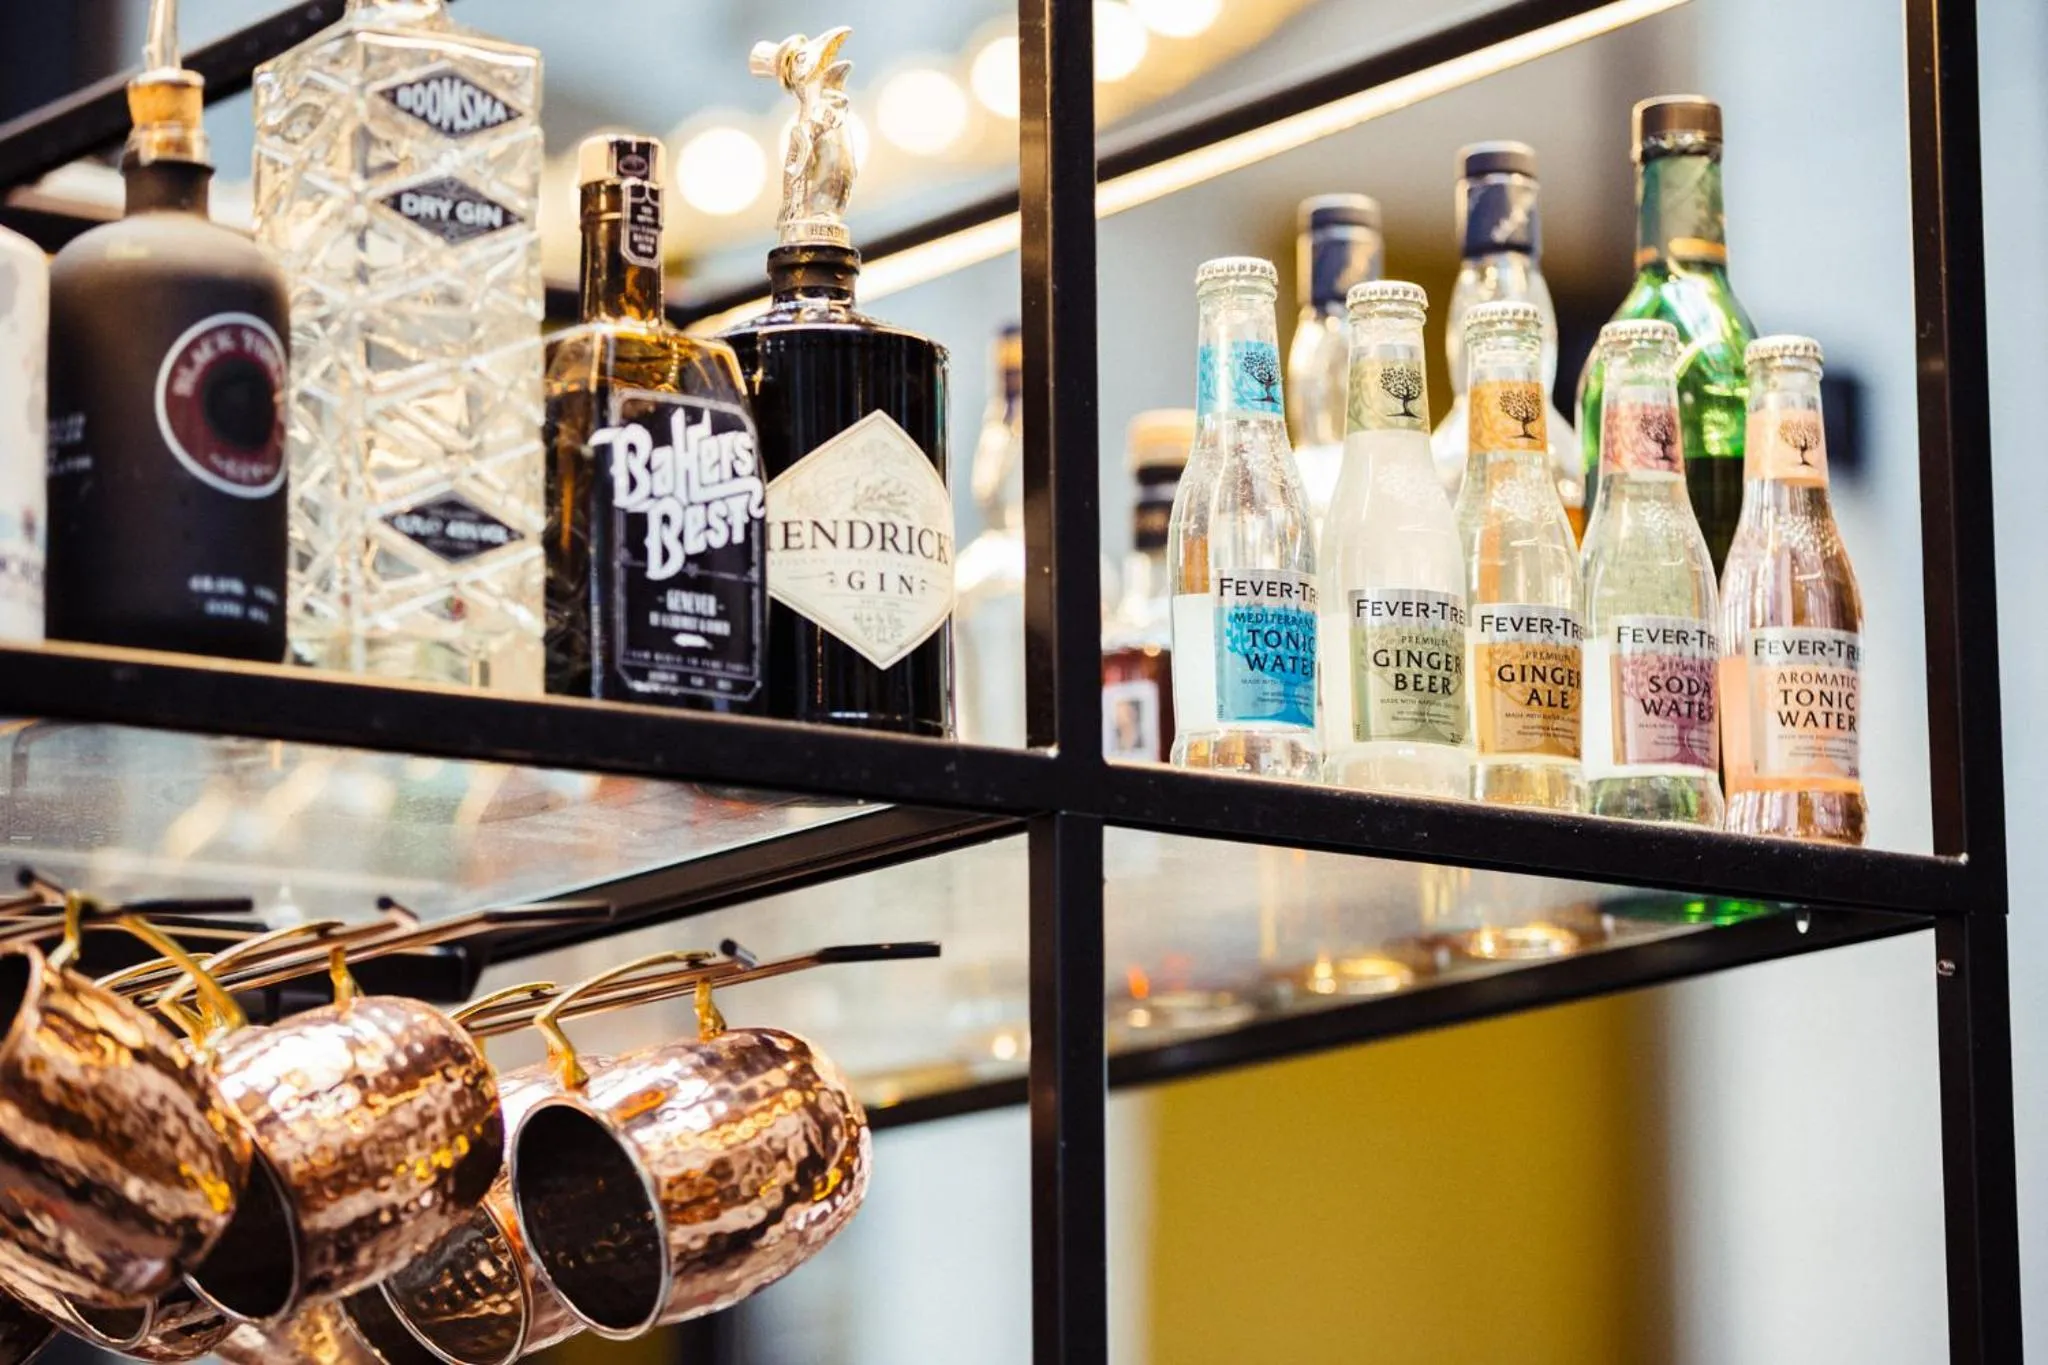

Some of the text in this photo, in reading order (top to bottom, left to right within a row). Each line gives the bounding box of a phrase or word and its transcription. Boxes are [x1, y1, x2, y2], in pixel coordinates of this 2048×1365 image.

[397, 77, 508, 132] BOOMSMA
[401, 192, 503, 228] DRY GIN
[847, 571, 914, 596] GIN
[1219, 578, 1320, 604] FEVER-TR
[1373, 649, 1462, 675] GINGER
[1395, 673, 1451, 696] BEER
[1648, 675, 1712, 700] SODA
[1776, 671, 1857, 690] AROMATIC
[1526, 688, 1570, 710] ALE
[1779, 689, 1856, 712] TONIC
[1777, 710, 1857, 733] WATER
